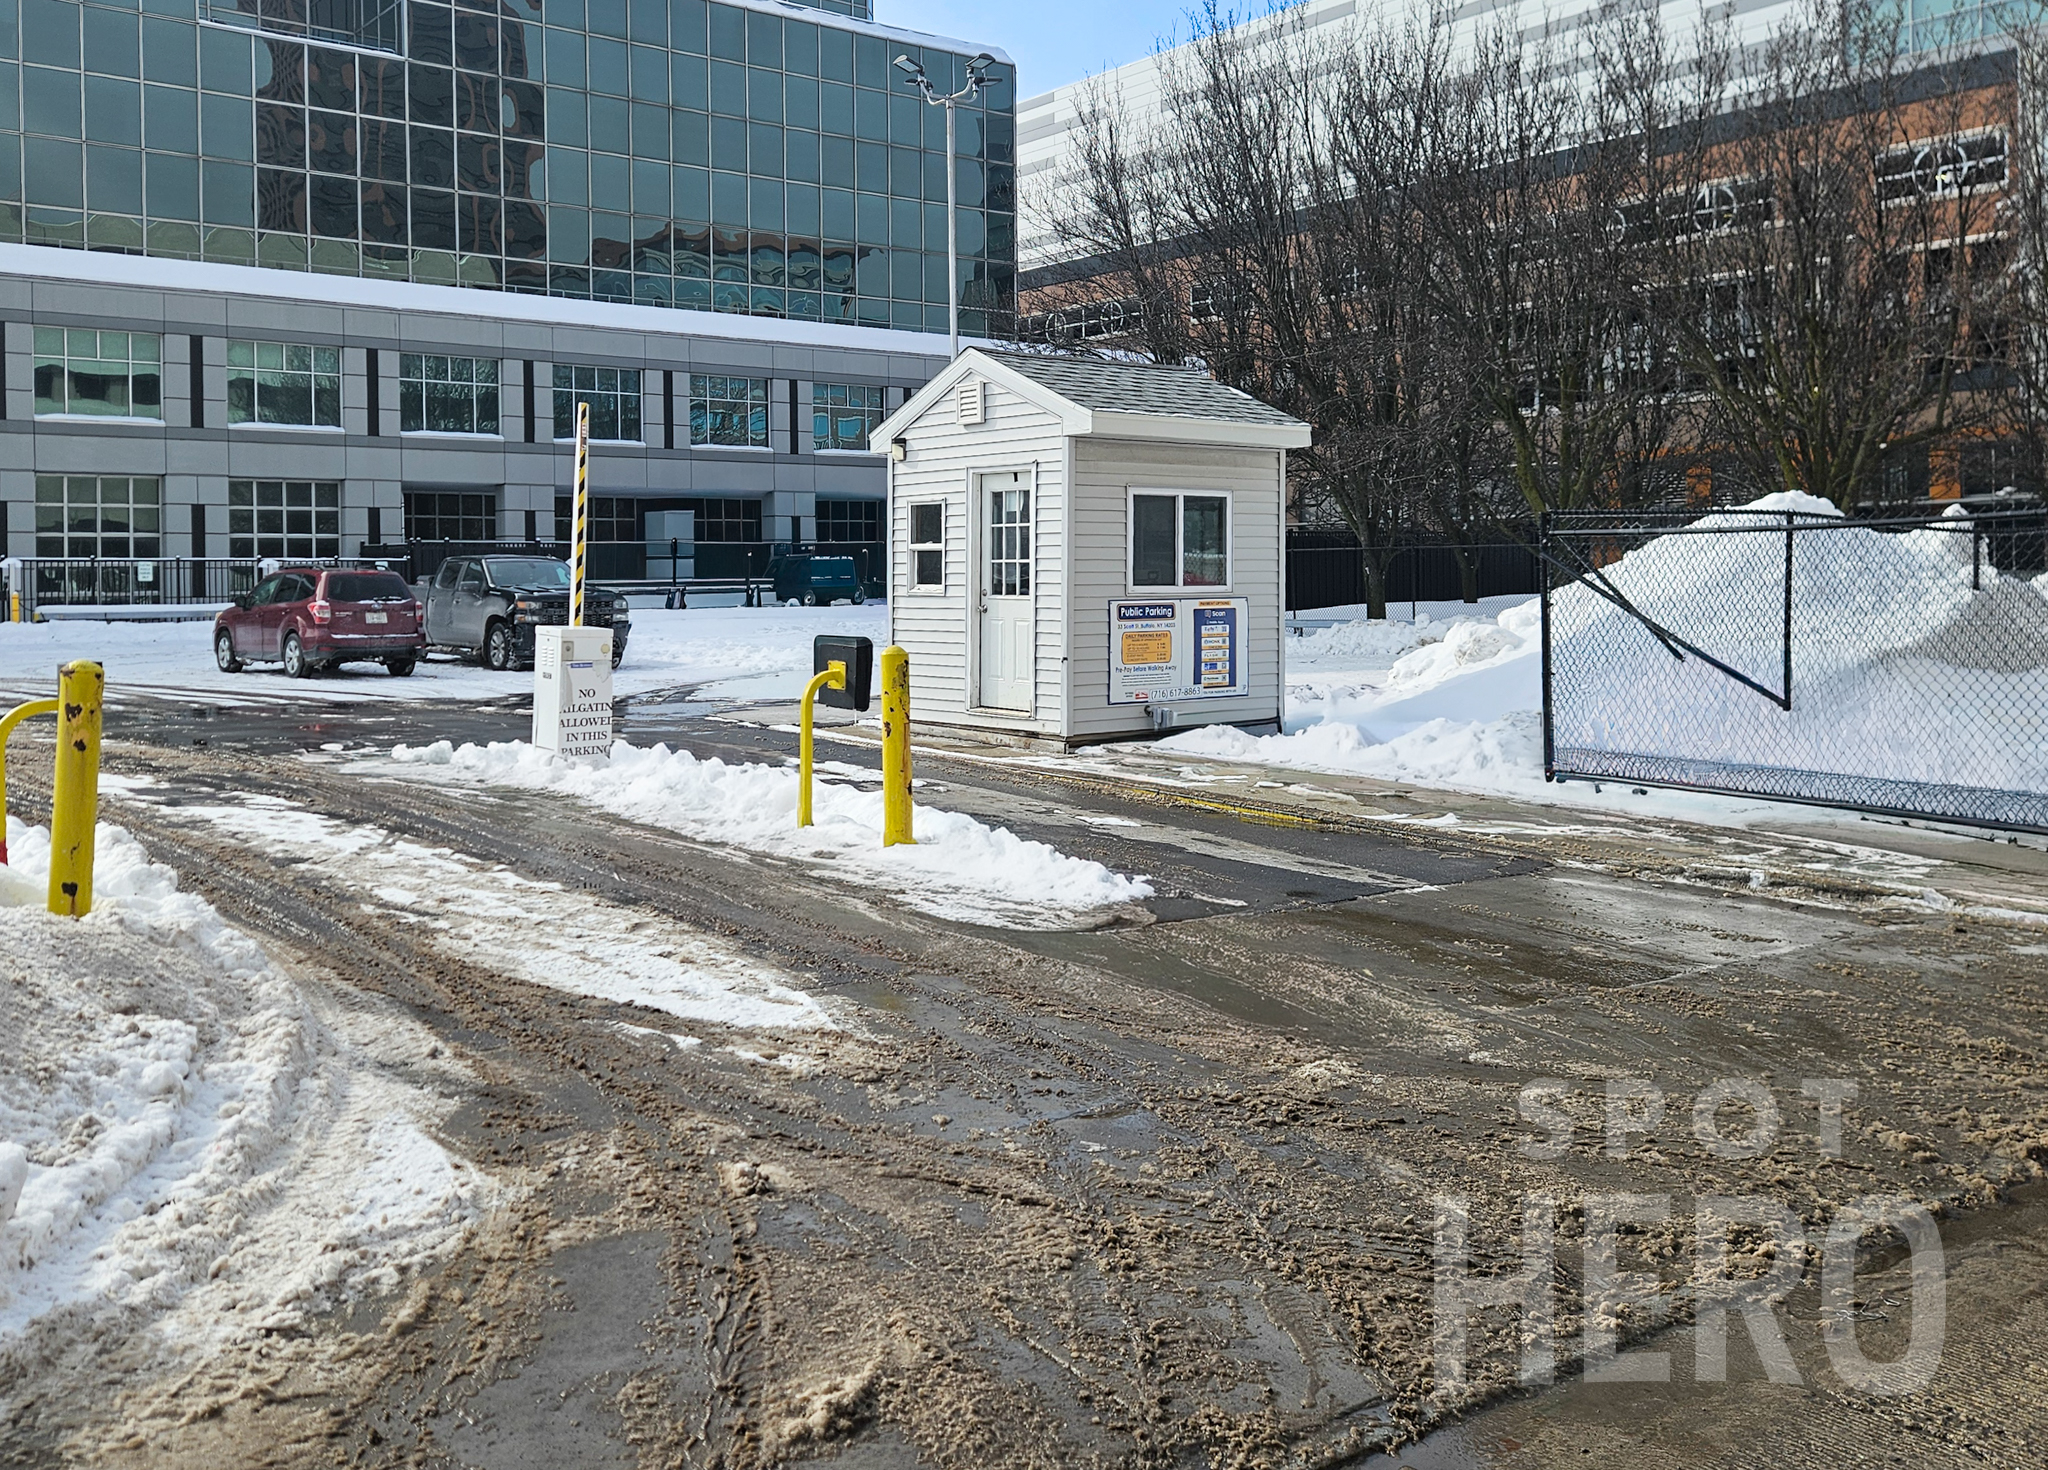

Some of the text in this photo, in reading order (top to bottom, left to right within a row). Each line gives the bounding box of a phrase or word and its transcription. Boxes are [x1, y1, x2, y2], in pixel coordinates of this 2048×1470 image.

[1120, 606, 1172, 617] Public Parking
[1148, 664, 1164, 672] Walking
[578, 688, 596, 698] NO
[1151, 690, 1168, 699] (716)
[1169, 687, 1201, 697] 617-8863
[566, 731, 607, 742] IN THIS
